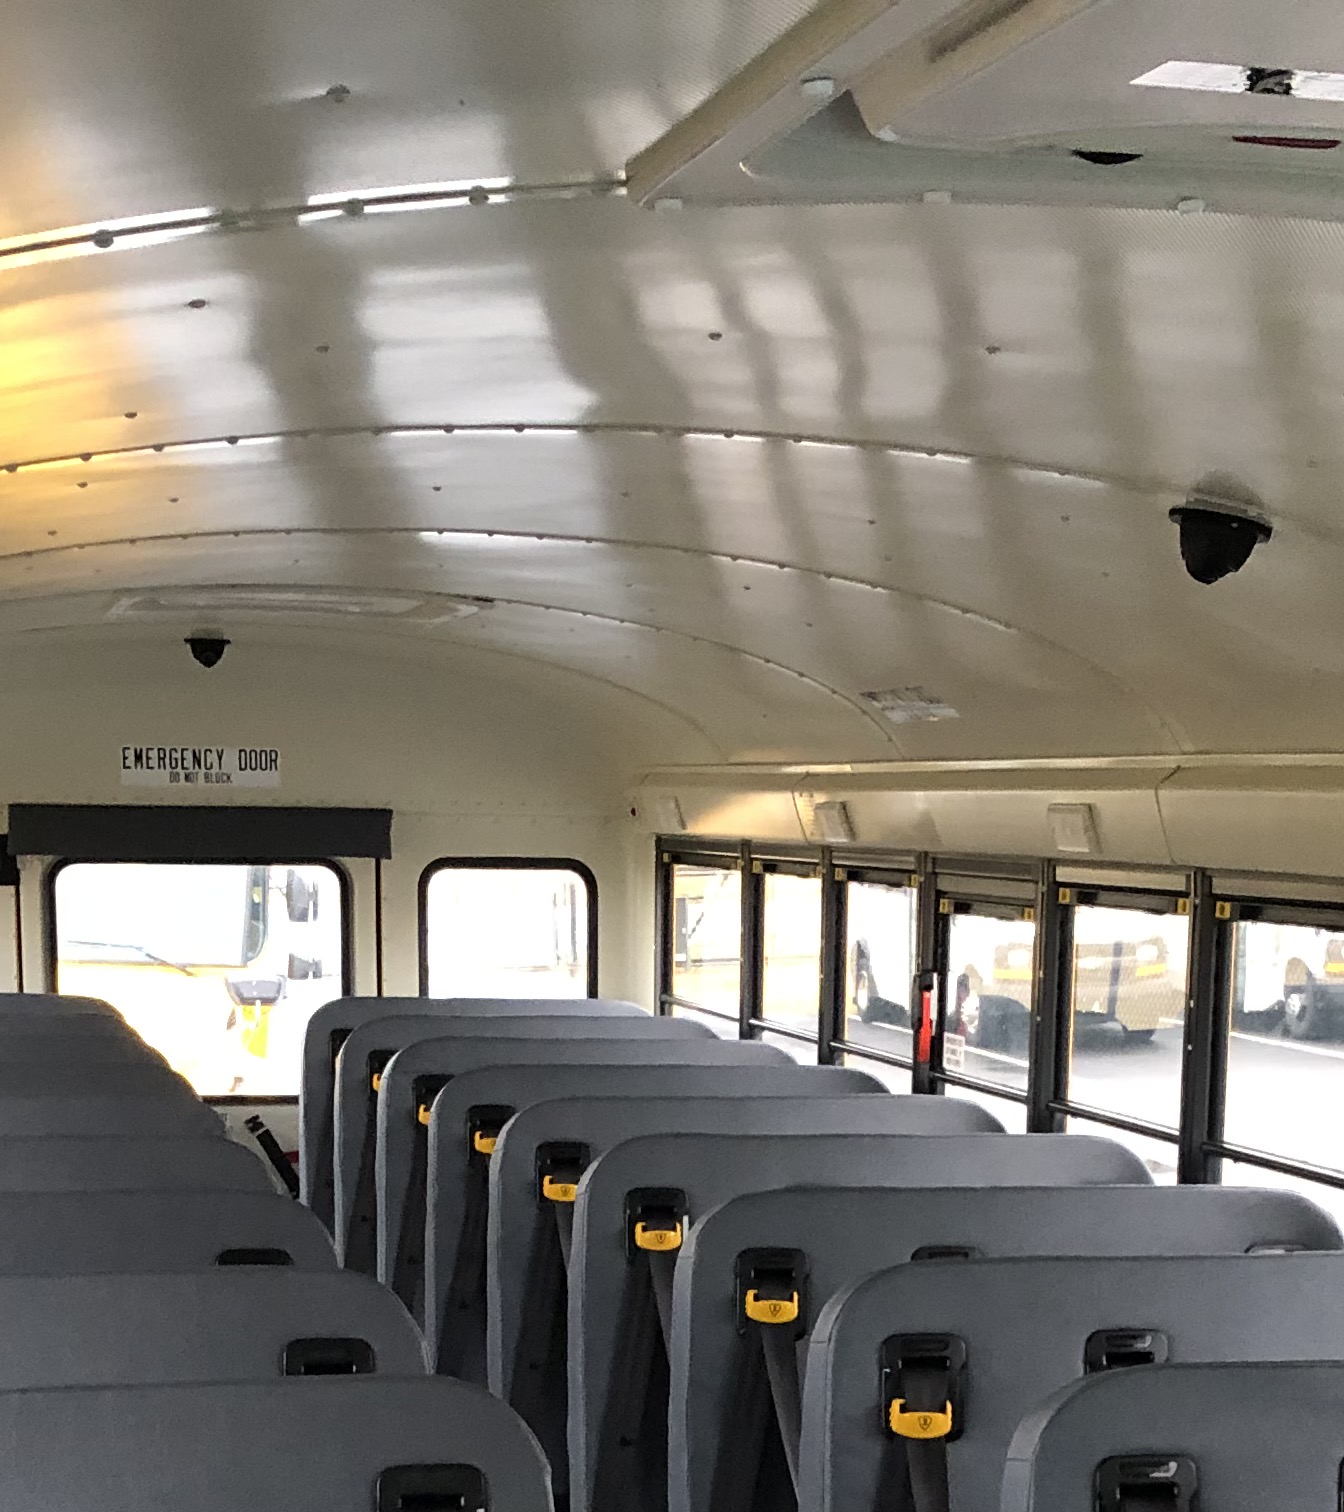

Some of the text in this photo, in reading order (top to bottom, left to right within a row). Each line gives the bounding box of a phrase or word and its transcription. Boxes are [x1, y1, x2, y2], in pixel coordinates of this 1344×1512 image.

[122, 747, 279, 771] EMERGENCY DOOR
[169, 772, 233, 784] DO NOT BLOCK
